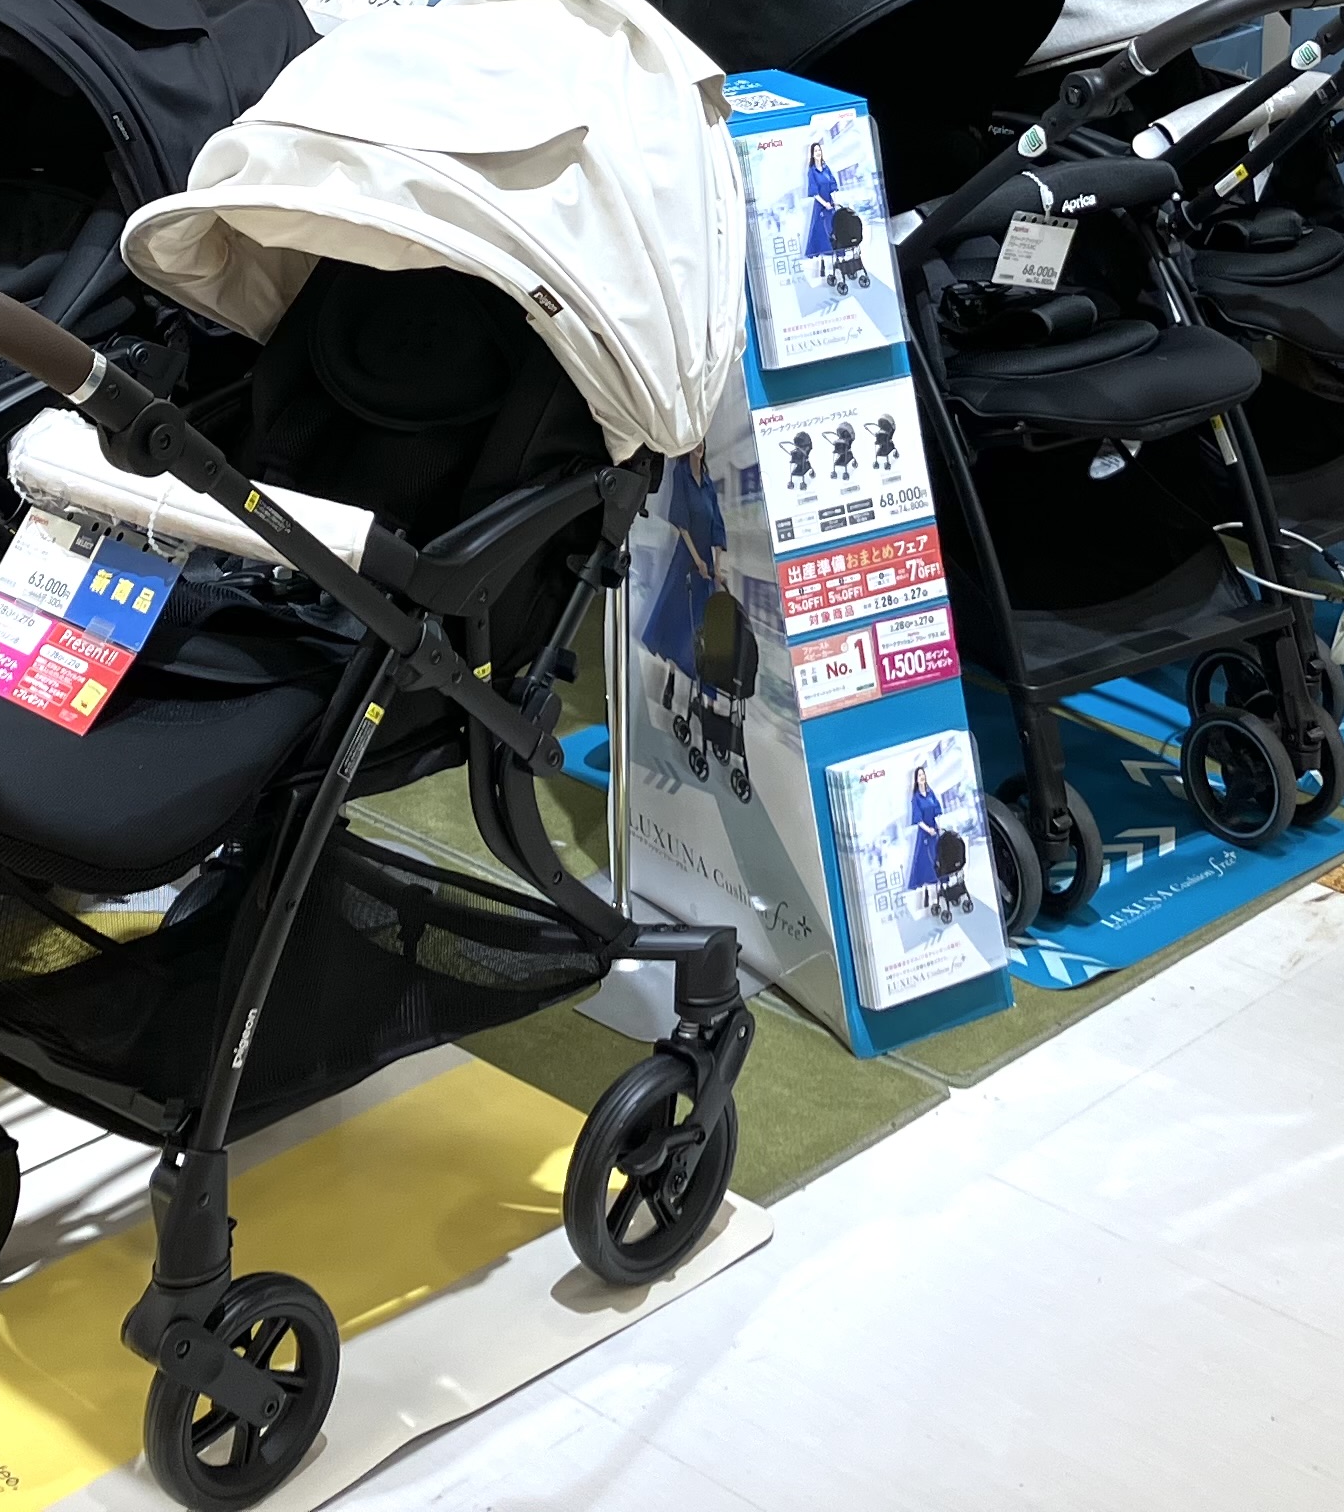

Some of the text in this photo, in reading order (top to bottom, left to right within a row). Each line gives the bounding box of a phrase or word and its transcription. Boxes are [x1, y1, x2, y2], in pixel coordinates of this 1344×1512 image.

[1061, 193, 1097, 213] Aprica
[758, 413, 784, 427] Aprica
[787, 534, 929, 584] 出産準備おまとめフェア
[881, 649, 927, 682] 1,500
